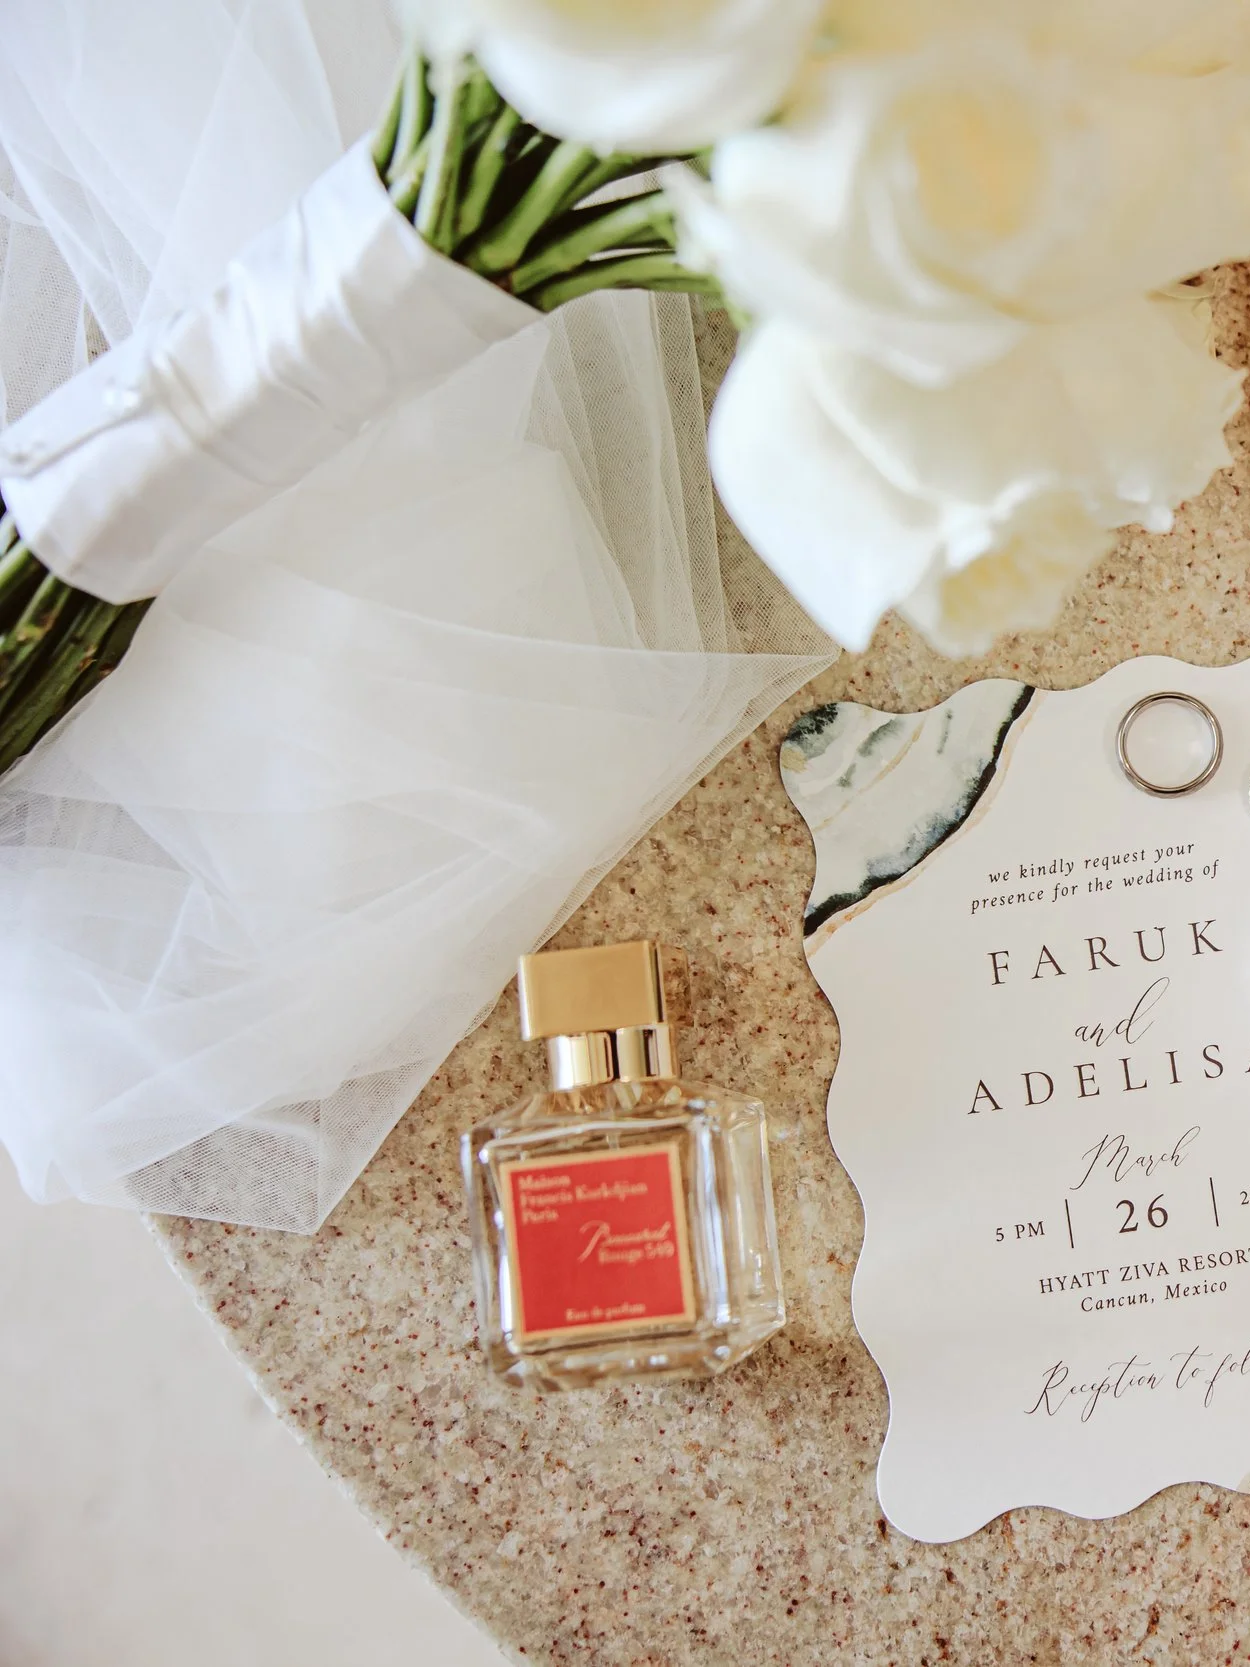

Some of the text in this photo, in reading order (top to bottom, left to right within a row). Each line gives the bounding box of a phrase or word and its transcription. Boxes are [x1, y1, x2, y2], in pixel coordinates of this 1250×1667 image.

[971, 859, 1220, 914] presence for the wedding of
[988, 843, 1195, 883] we kindly request your
[988, 919, 1224, 986] FARUK
[1075, 976, 1170, 1047] and
[1069, 1125, 1201, 1190] March
[995, 1227, 1005, 1242] 5
[1015, 1221, 1046, 1239] PM
[1116, 1193, 1169, 1234] 26
[1039, 1269, 1110, 1294] HYATT
[1120, 1261, 1170, 1282] ZIVA
[1080, 1280, 1228, 1312] Cancun, Mexico
[1024, 1355, 1163, 1423] Reception
[1170, 1346, 1213, 1389] to
